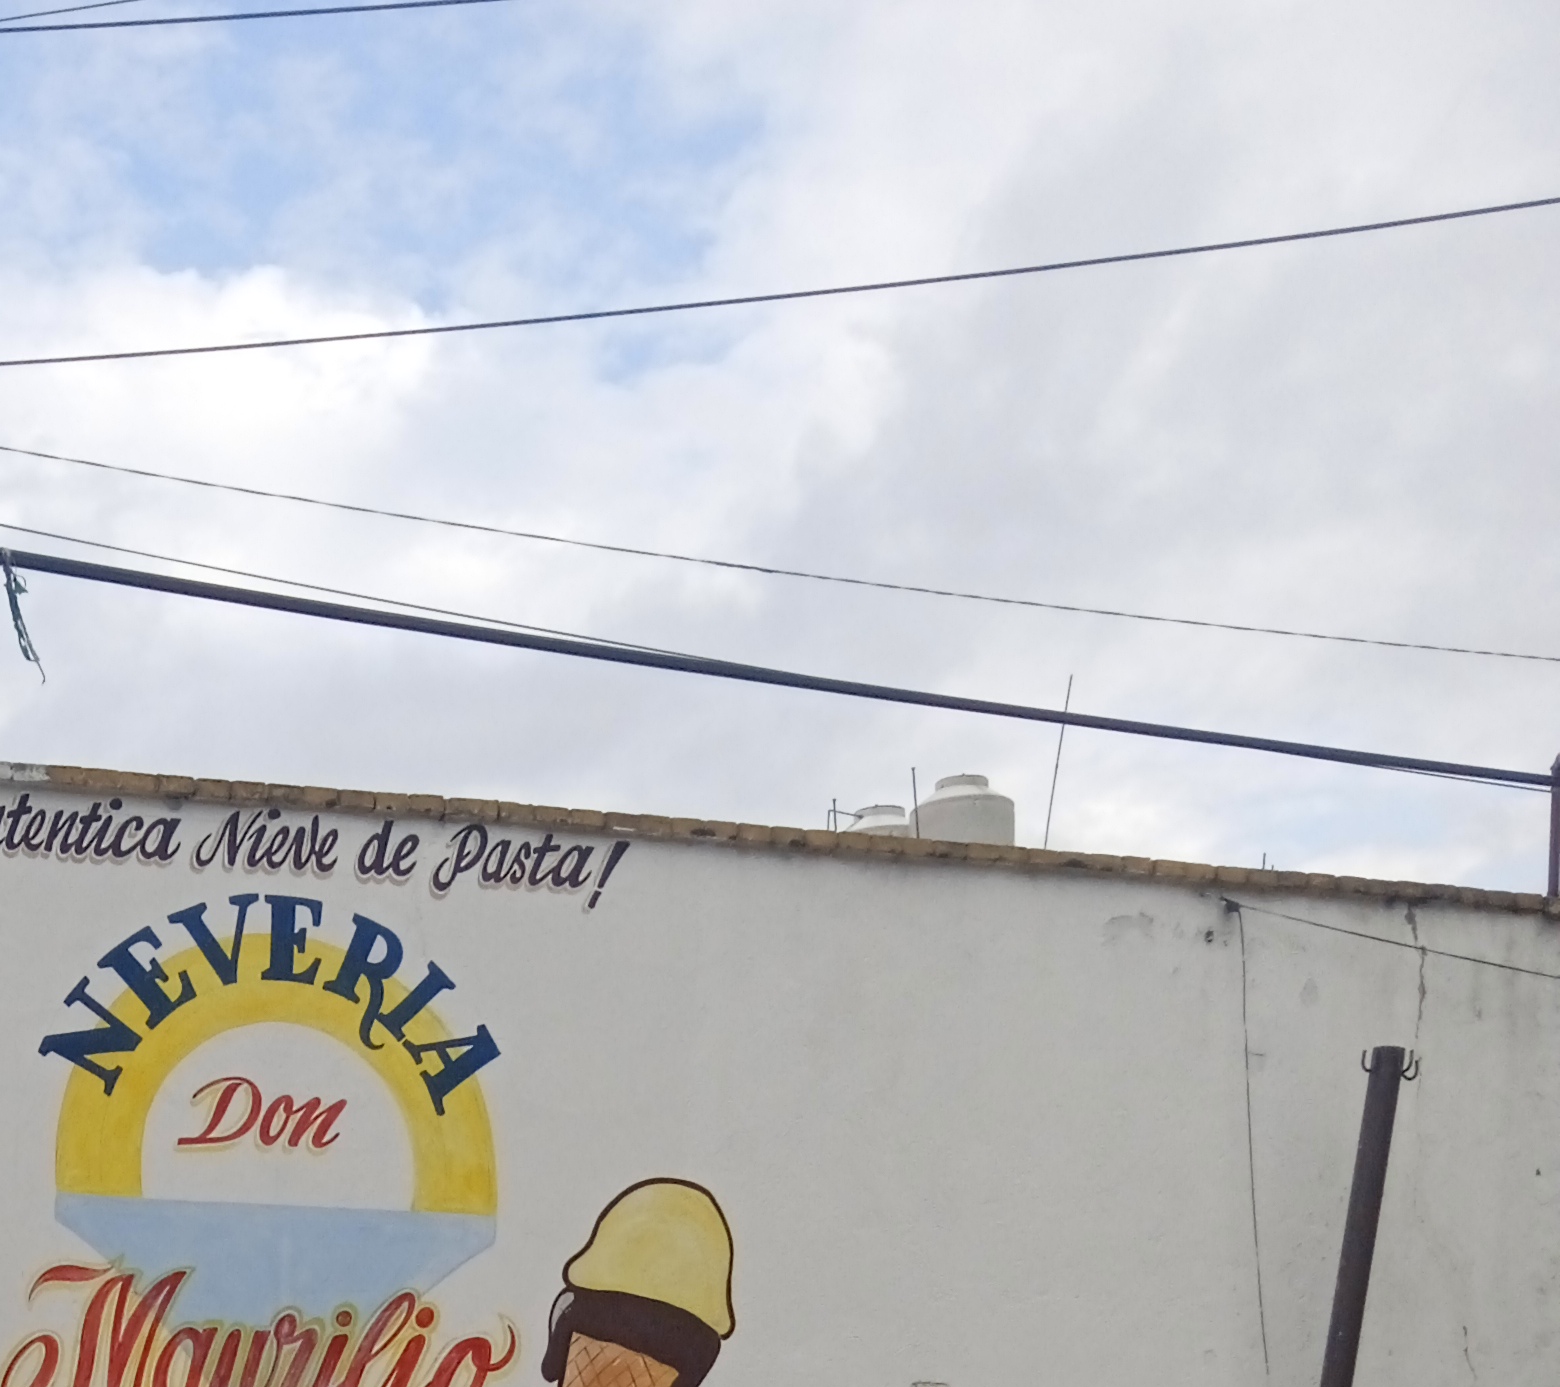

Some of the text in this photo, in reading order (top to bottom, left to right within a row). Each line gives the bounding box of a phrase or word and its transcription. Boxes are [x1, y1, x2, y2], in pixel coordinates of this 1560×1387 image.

[196, 807, 340, 874] Nieve
[356, 819, 420, 879] de
[433, 822, 630, 910] Pasta!
[38, 892, 501, 1117] NEVERIA
[176, 1076, 348, 1150] Don
